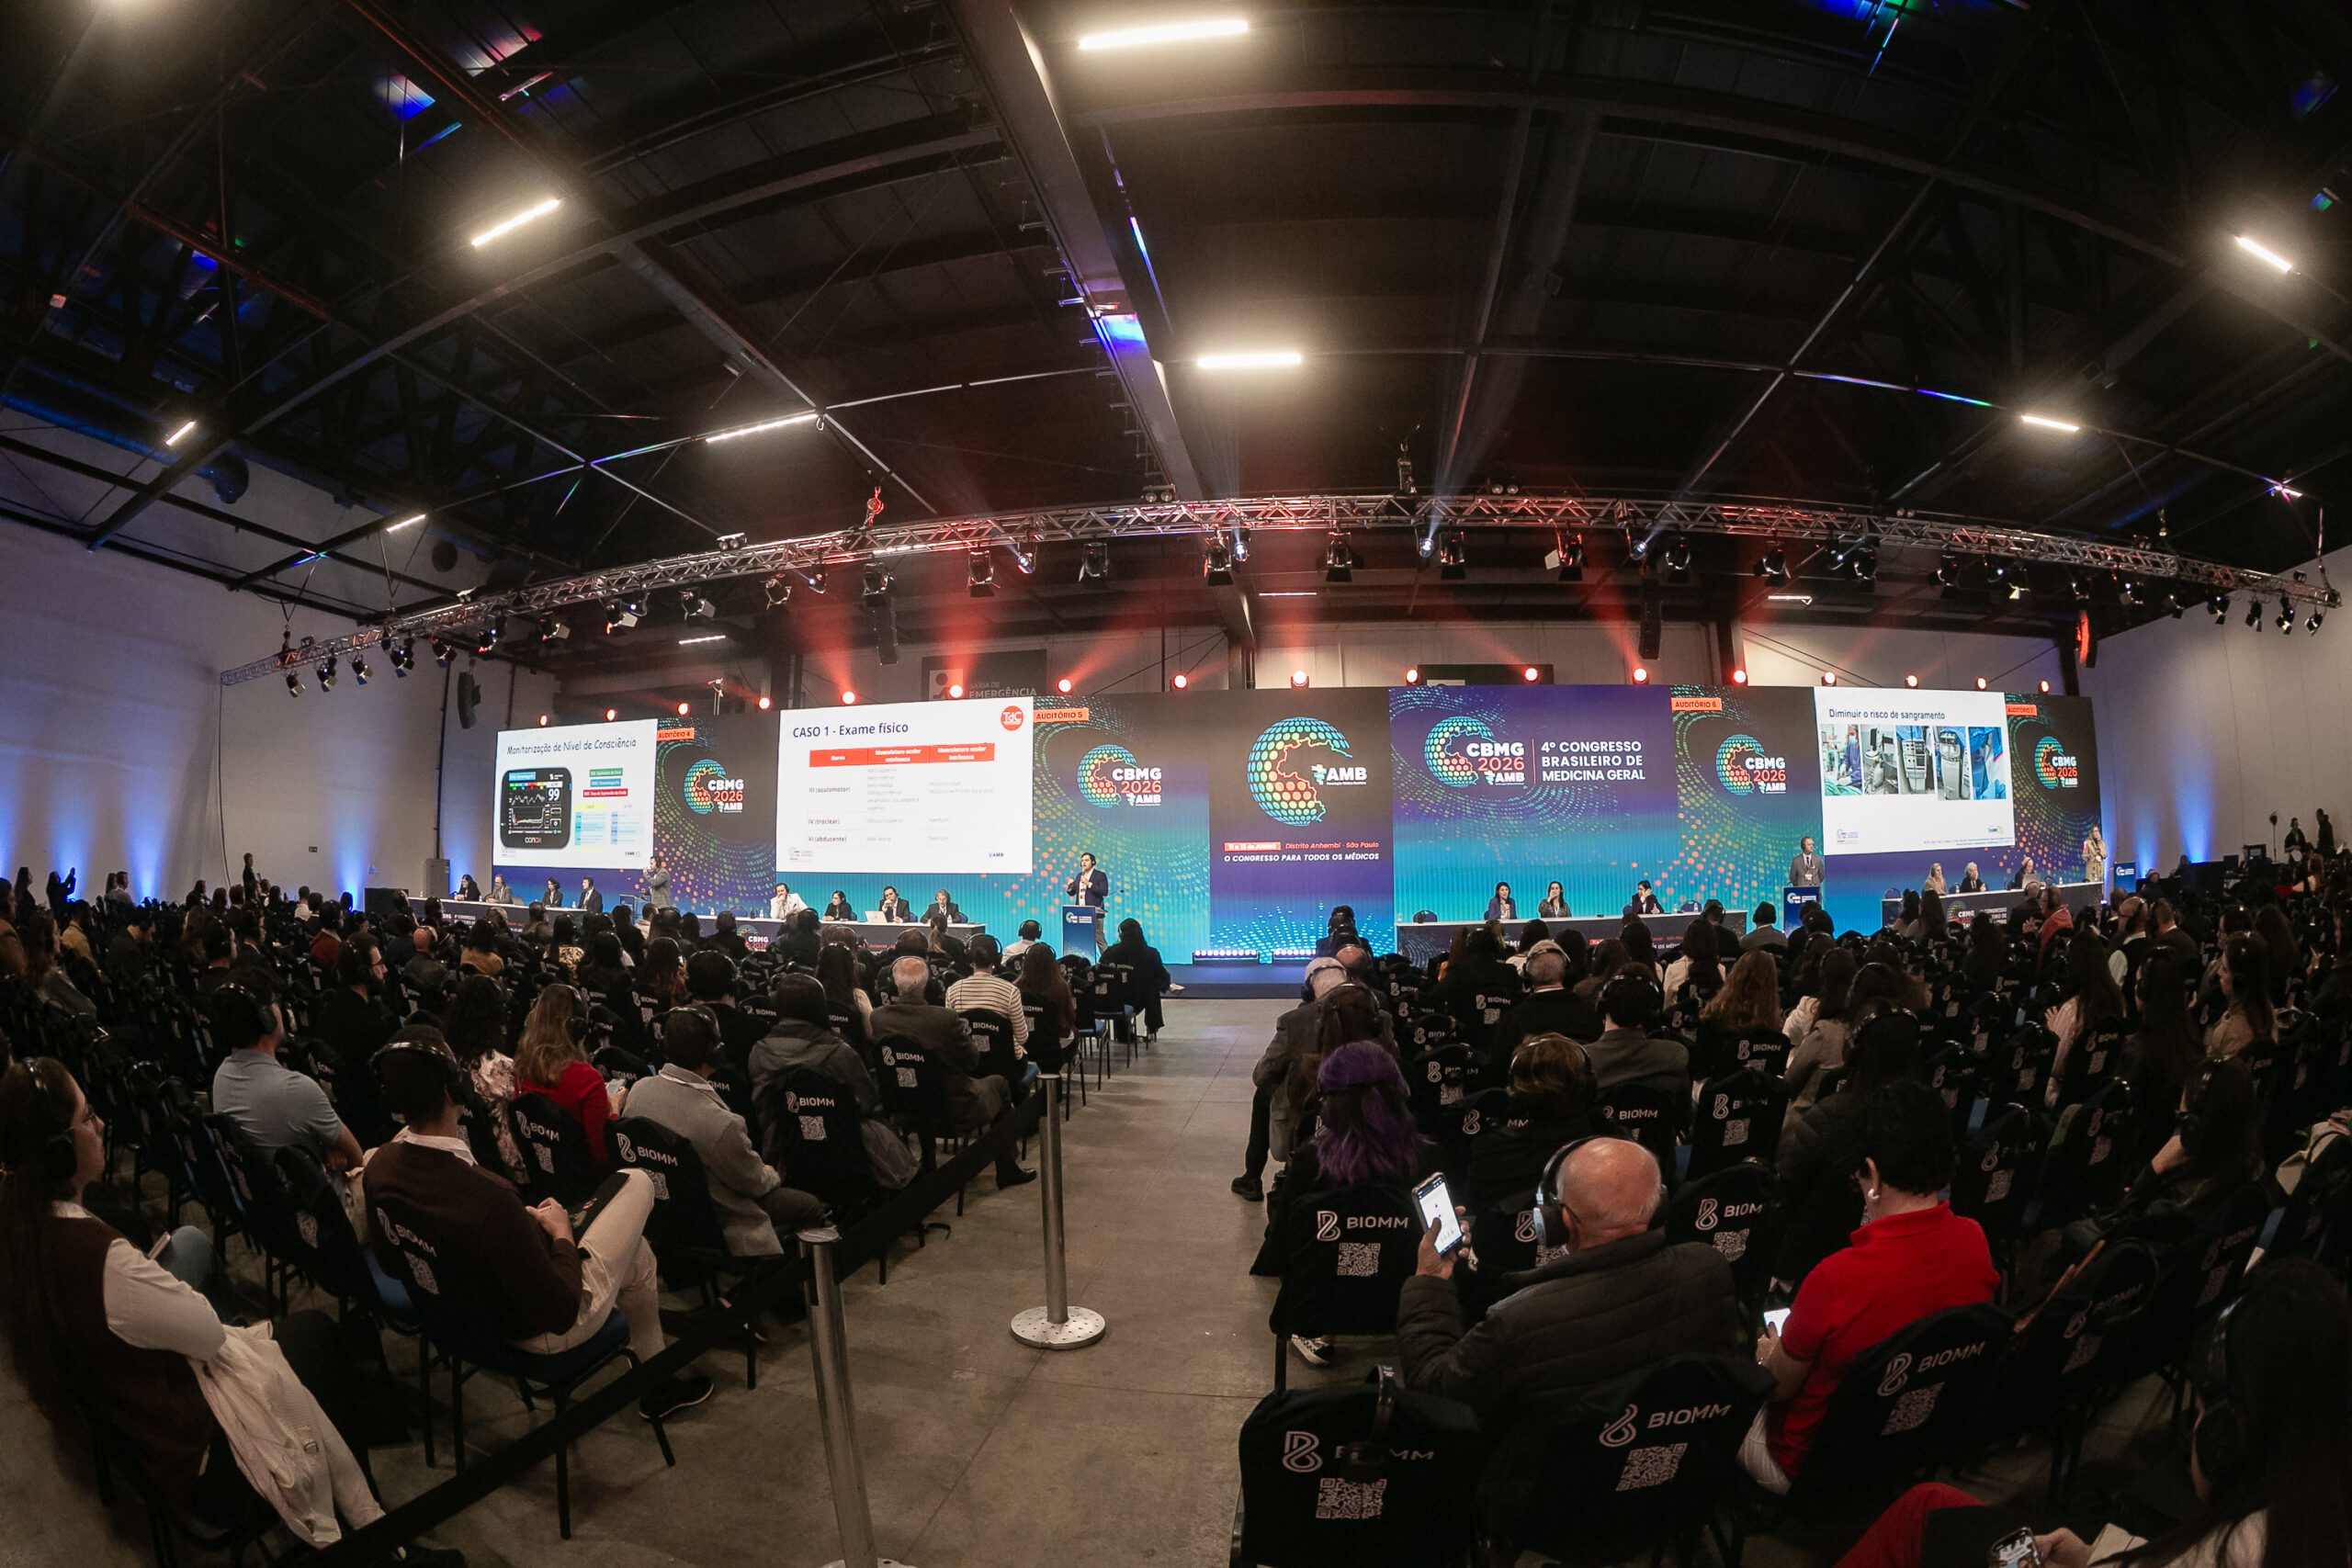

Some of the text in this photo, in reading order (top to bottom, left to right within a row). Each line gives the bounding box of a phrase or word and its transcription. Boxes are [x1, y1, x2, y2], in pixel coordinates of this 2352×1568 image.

[969, 686, 1037, 698] EMERGÊNCIA
[1002, 711, 1023, 722] TdC
[1036, 711, 1076, 719] AUDITÓRIO
[1829, 709, 1861, 717] Diminuir
[1871, 710, 1888, 718] risco
[1890, 711, 1898, 719] de
[1901, 712, 1945, 721] sangramento
[793, 726, 820, 738] CASO
[825, 726, 829, 736] 1
[840, 724, 876, 736] Exame
[878, 722, 909, 735] físico
[507, 738, 637, 754] Monitorização de Nível de Consciência
[1466, 742, 1525, 757] CBMG
[1559, 740, 1642, 752] CONGRESSO
[1477, 757, 1525, 772] 2026
[1542, 755, 1643, 767] BRASILEIRO DE
[1746, 757, 1786, 770] CBMG
[2052, 756, 2076, 767] CBMG
[1112, 767, 1162, 781] CBMG
[1326, 766, 1368, 781] AMB
[1495, 773, 1525, 783] AMB
[1542, 769, 1645, 782] MEDICINA GERAL
[1753, 770, 1786, 783] 2026
[2057, 767, 2077, 777] 2026
[707, 779, 744, 791] CBMG
[1121, 781, 1162, 794] 2026
[1766, 783, 1786, 792] AMB
[548, 788, 560, 801] 99
[713, 790, 743, 802] 2026
[1136, 795, 1161, 804] AMB
[724, 802, 743, 810] AMB
[1346, 840, 1359, 849] São
[1232, 854, 1280, 863] CONGRESSO
[1281, 853, 1302, 862] PARA
[1344, 852, 1380, 861] MÉDICOS
[748, 935, 769, 943] CBMG
[1487, 997, 1511, 1005] BIOMM
[755, 1008, 777, 1017] BIOMM
[972, 1021, 999, 1032] BIOMM
[1752, 1043, 1781, 1052] BIOMM
[896, 1052, 924, 1063] BIOMM
[707, 1080, 731, 1091] OMM
[799, 1097, 835, 1107] BIOMM
[1619, 1109, 1658, 1121] BIOMM
[638, 1147, 678, 1167] BIOMM
[1724, 1202, 1763, 1218] BIOM
[1347, 1215, 1409, 1229] BIOMM
[1917, 1341, 1985, 1374] BIOMM
[1647, 1404, 1732, 1429] BIOMM
